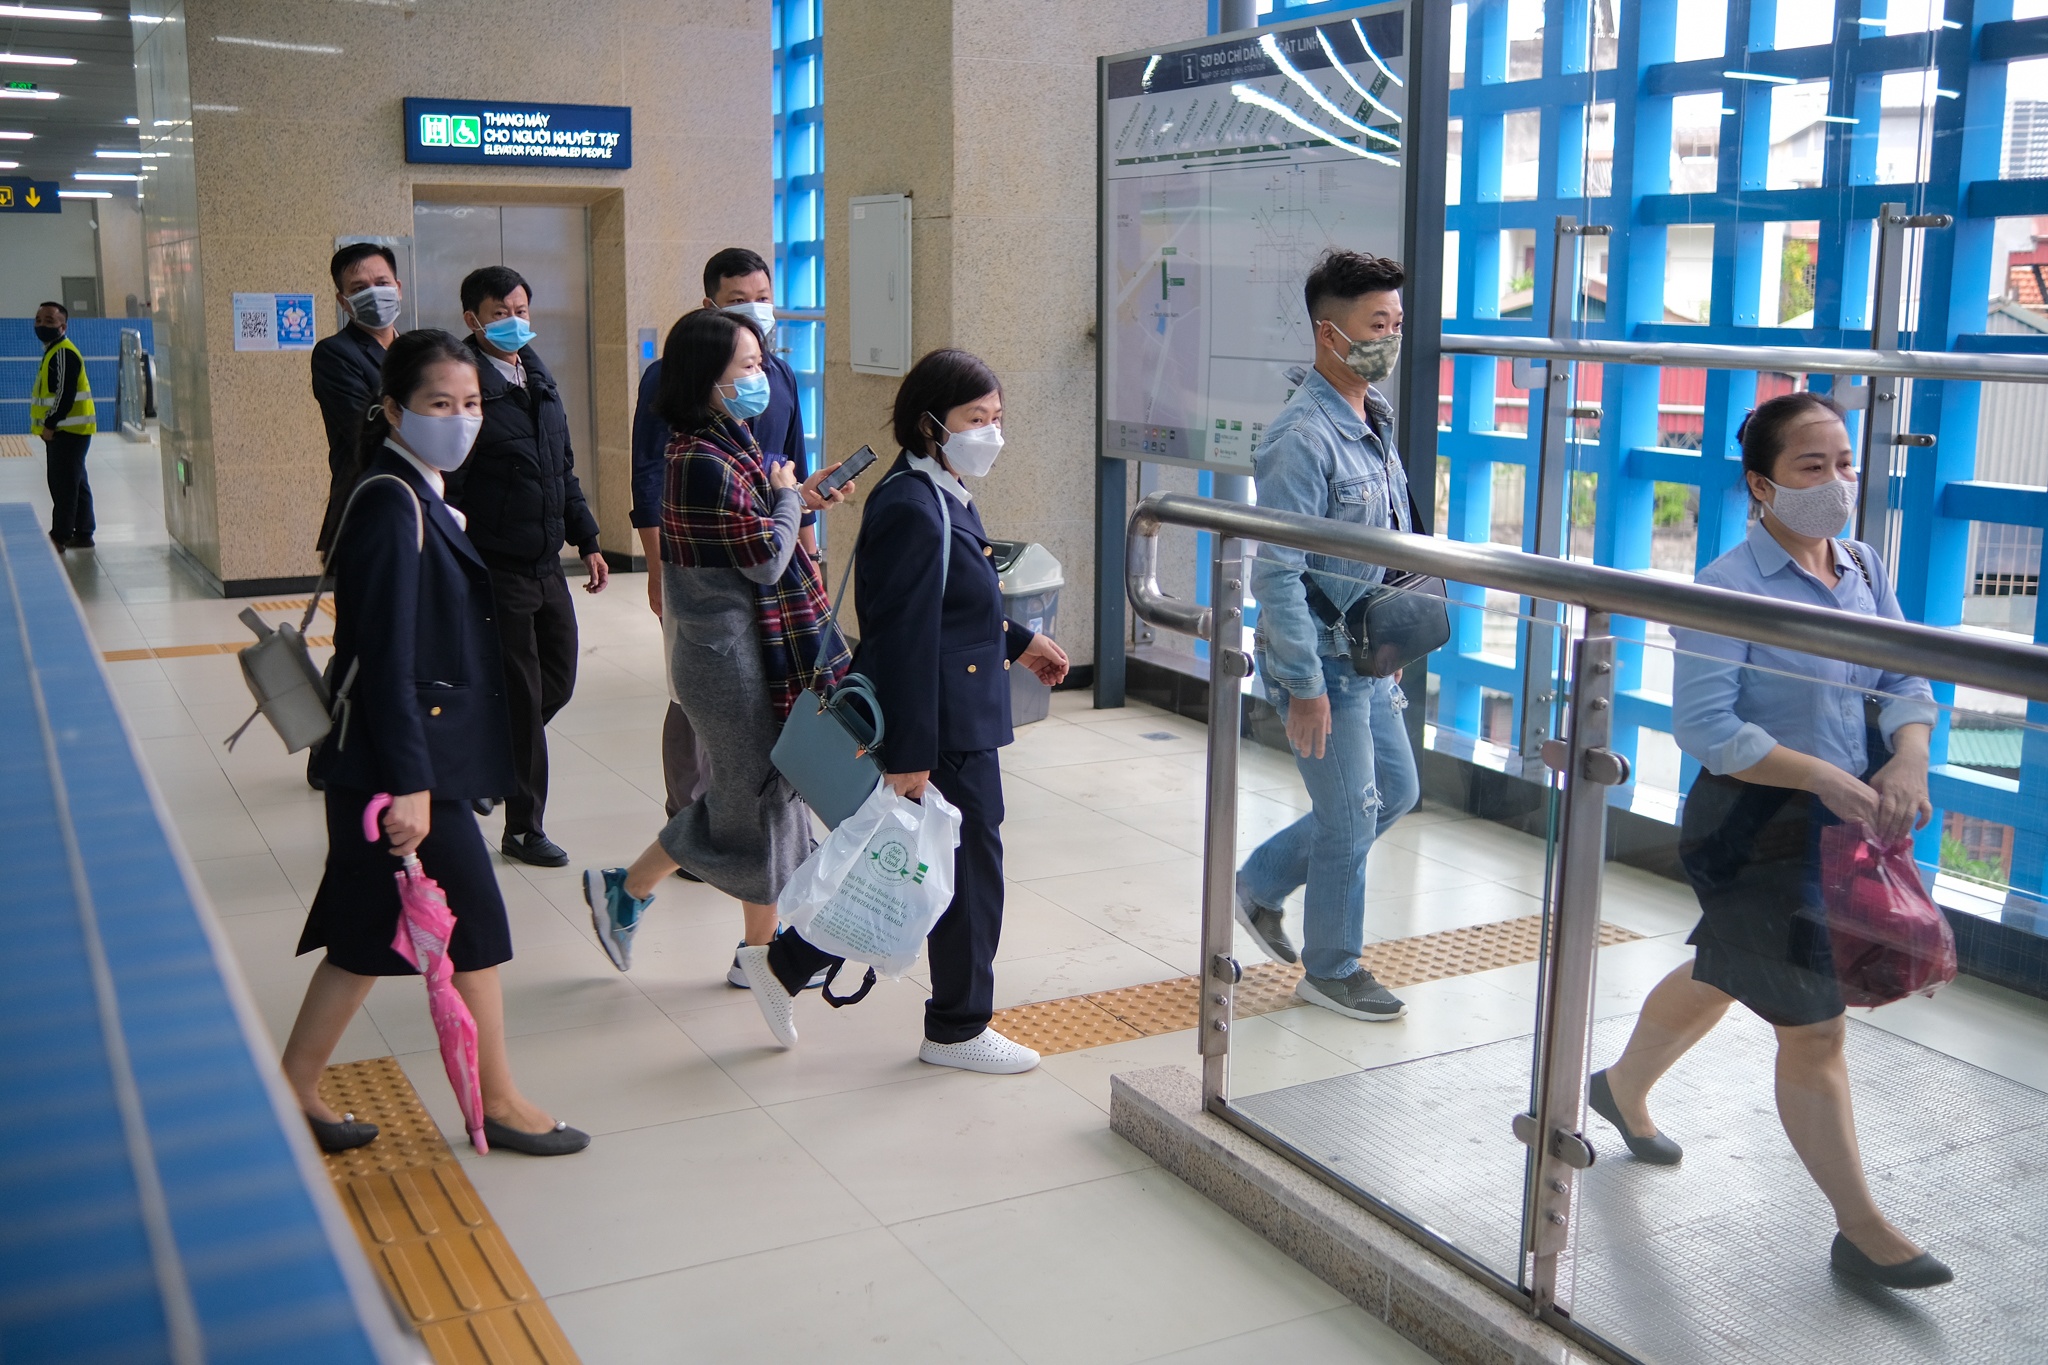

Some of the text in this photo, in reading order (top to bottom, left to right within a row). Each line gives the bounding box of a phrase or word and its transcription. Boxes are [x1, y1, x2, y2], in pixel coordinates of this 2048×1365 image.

[1297, 37, 1319, 52] LINH
[1200, 54, 1213, 68] SƠ
[1214, 49, 1226, 66] ĐỒ
[1227, 46, 1242, 63] CHỈ
[1200, 71, 1212, 80] MAP
[1212, 70, 1219, 78] OF
[1243, 63, 1266, 73] STATION
[1371, 72, 1385, 94] LINH
[483, 112, 550, 128] THANG MÁY
[484, 129, 620, 149] CHO NGƯỜI KHUYẾT TẬT
[484, 144, 612, 159] ELEVATOR FOR DISABLED PEOPLE
[849, 894, 882, 915] NEWZEALAND
[883, 913, 904, 927] CANADA
